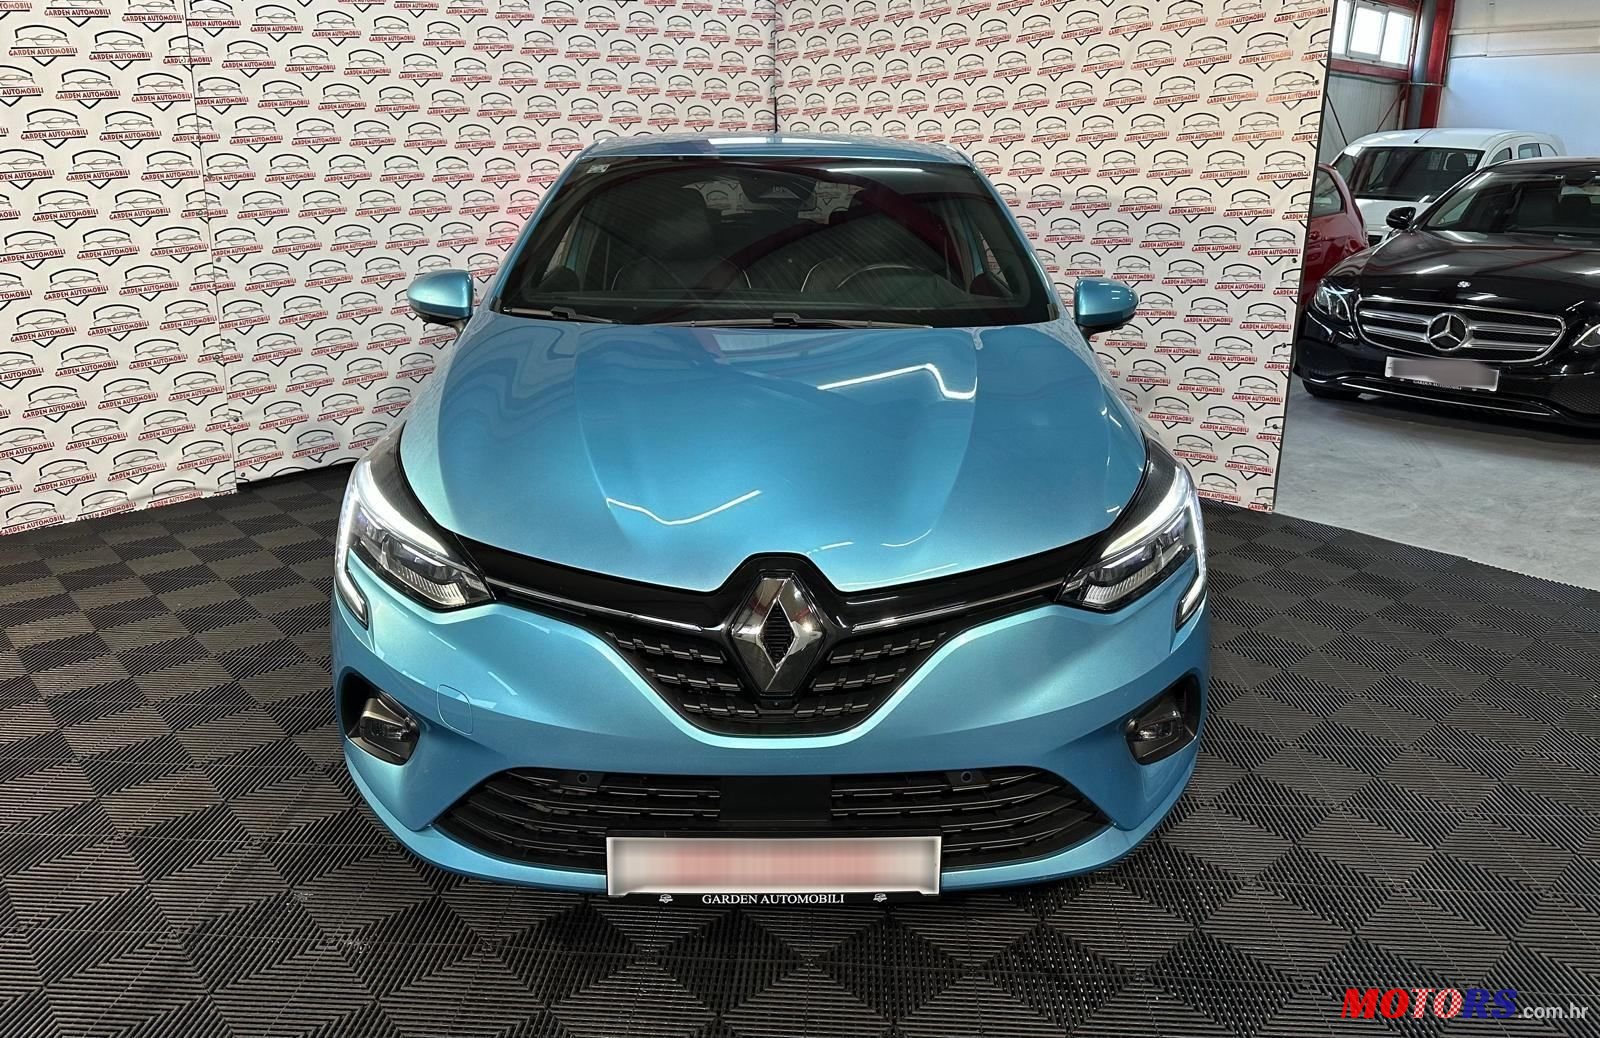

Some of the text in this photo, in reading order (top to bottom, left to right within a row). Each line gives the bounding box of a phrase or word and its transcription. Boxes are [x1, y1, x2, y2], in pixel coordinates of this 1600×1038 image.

[147, 13, 187, 21] AUTOMOBILI
[1215, 17, 1234, 27] GARDEN
[1274, 13, 1295, 24] GARDEN
[9, 47, 77, 56] GARDEN AUTOMOBILI
[89, 51, 152, 61] GARDEN AUTOMOBILI
[2, 86, 43, 96] AUTOMOBILI
[56, 89, 120, 100] GARDEN AUTOMOBILI
[132, 91, 193, 103] GARDEN AUTOMOBILI
[21, 127, 88, 140] GARDEN AUTOMOBILI
[99, 128, 161, 142] GARDEN AUTOMOBILI
[66, 168, 130, 182] GARDEN AUTOMOBILI
[141, 168, 201, 181] GARDEN AUTOMOBILI
[32, 207, 98, 222] GARDEN AUTOMOBILI
[109, 206, 170, 220] GARDEN AUTOMOBILI
[77, 244, 139, 261] GARDEN AUTOMOBILI
[150, 241, 208, 257] GARDEN AUTOMOBILI
[44, 283, 108, 301] GARDEN AUTOMOBILI
[119, 280, 179, 296] GARDEN AUTOMOBILI
[88, 319, 149, 337] GARDEN AUTOMOBILI
[160, 314, 217, 331] GARDEN AUTOMOBILI
[11, 325, 76, 342] GARDEN AUTOMOBILI
[55, 358, 118, 378] GARDEN AUTOMOBILI
[129, 352, 187, 369] GARDEN AUTOMOBILI
[3, 365, 43, 380] AUTOMOBILI
[98, 390, 158, 411] GARDEN AUTOMOBILI
[168, 383, 225, 402] GARDEN AUTOMOBILI
[22, 398, 87, 420] GARDEN AUTOMOBILI
[138, 422, 195, 441] GARDEN AUTOMOBILI
[66, 430, 127, 451] GARDEN AUTOMOBILI
[177, 451, 232, 471] GARDEN AUTOMOBILI
[108, 460, 166, 483] GARDEN AUTOMOBILI
[33, 470, 96, 494] GARDEN AUTOMOBILI
[702, 894, 844, 904] GARDEN AUTOMOBILI
